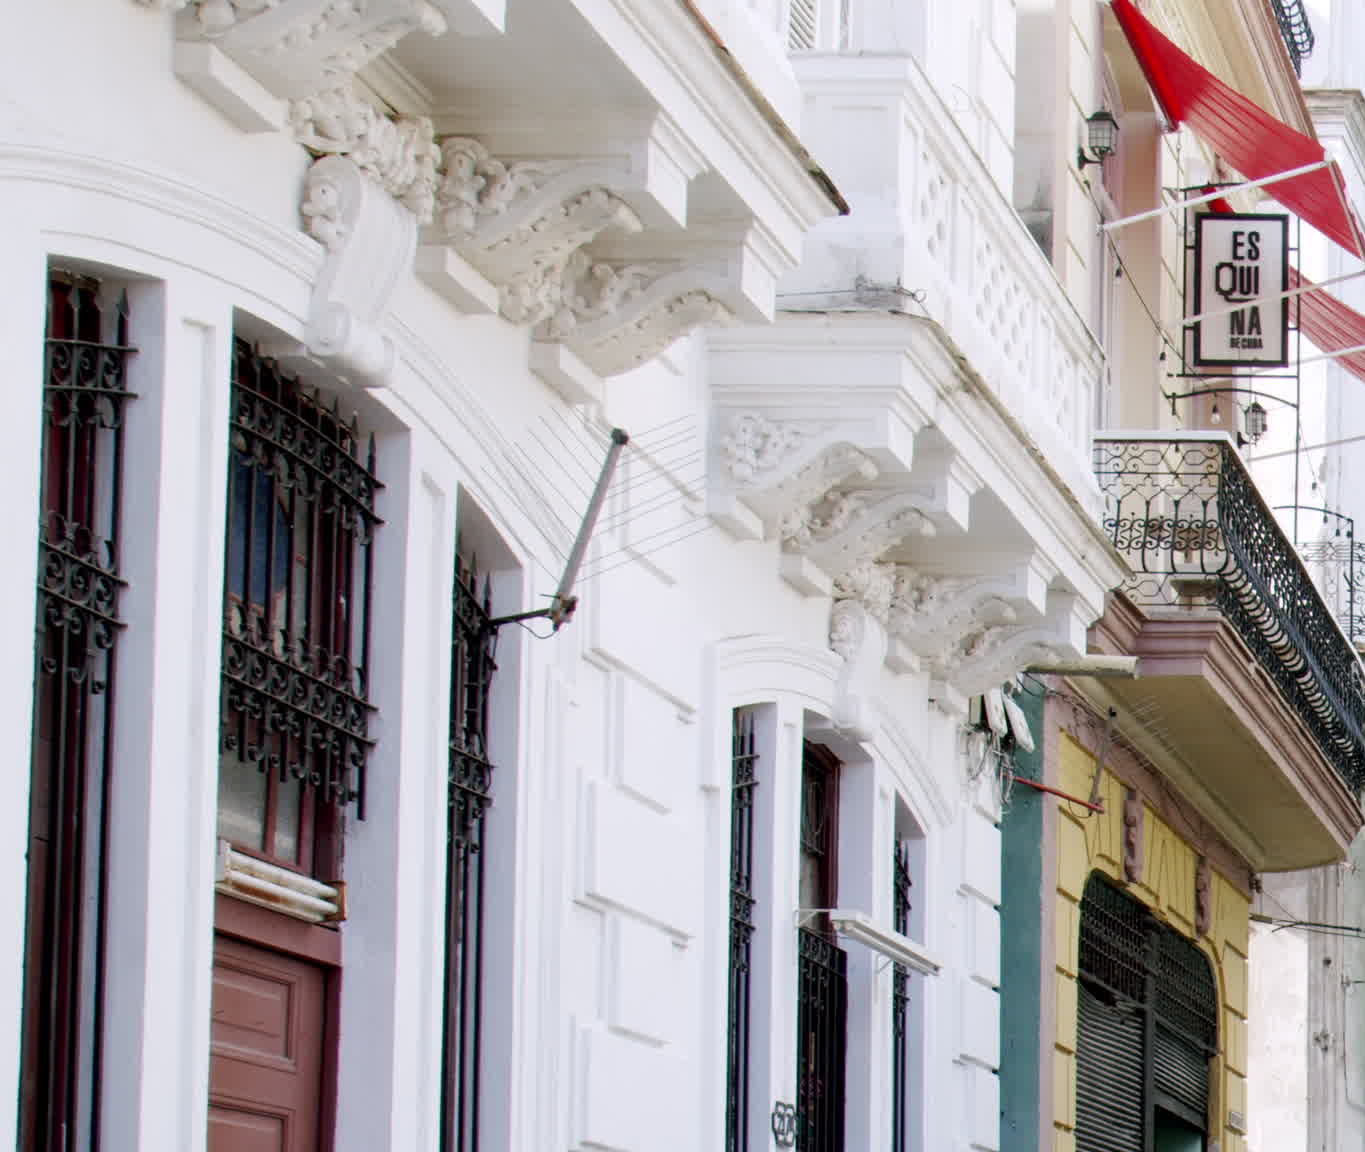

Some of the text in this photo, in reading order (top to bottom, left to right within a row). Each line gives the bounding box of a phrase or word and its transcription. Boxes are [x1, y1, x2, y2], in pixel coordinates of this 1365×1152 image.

[1232, 231, 1261, 261] ES
[1215, 262, 1260, 304] QUI
[1230, 306, 1262, 336] NA
